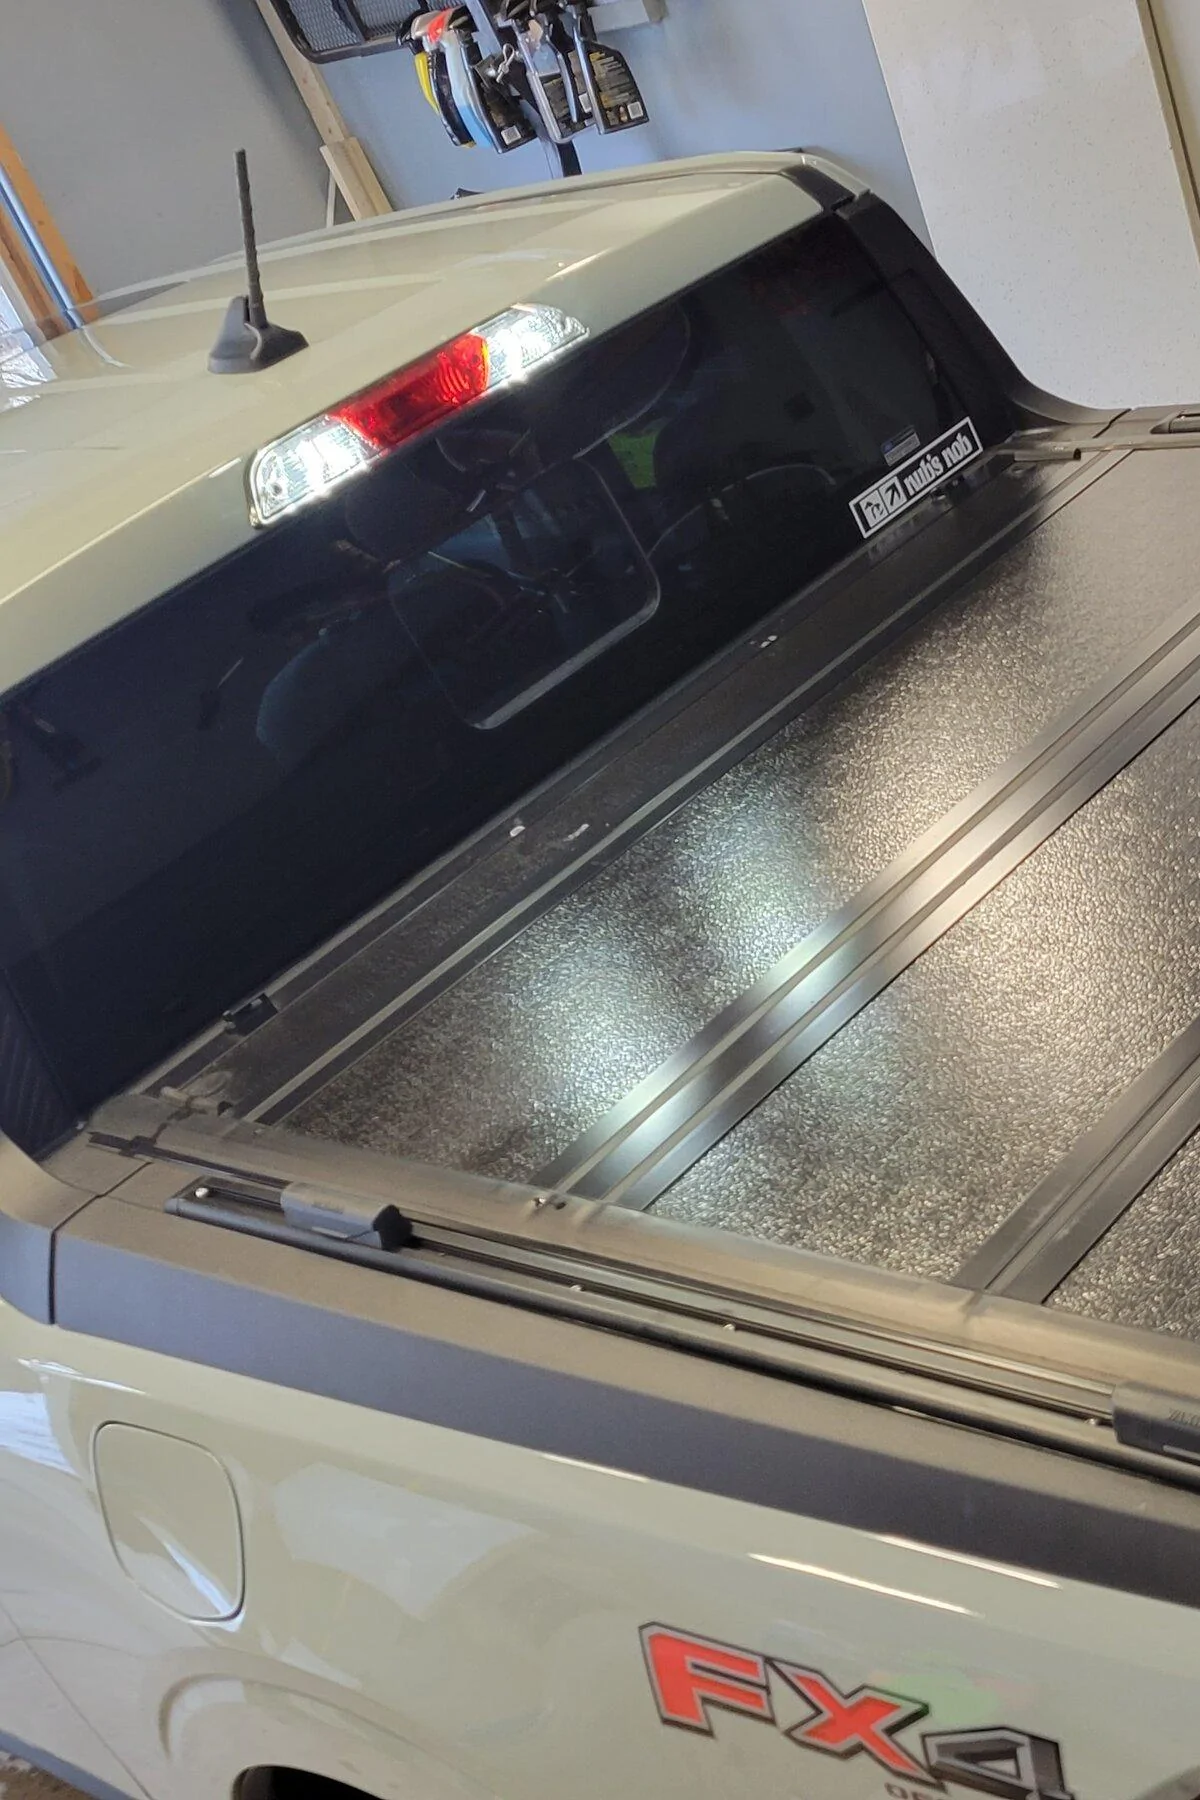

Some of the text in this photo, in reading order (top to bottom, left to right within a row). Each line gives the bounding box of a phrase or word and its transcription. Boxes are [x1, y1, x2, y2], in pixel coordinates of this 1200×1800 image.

[903, 454, 944, 497] nub's
[941, 432, 973, 469] nob
[638, 1620, 1076, 1800] FX4
